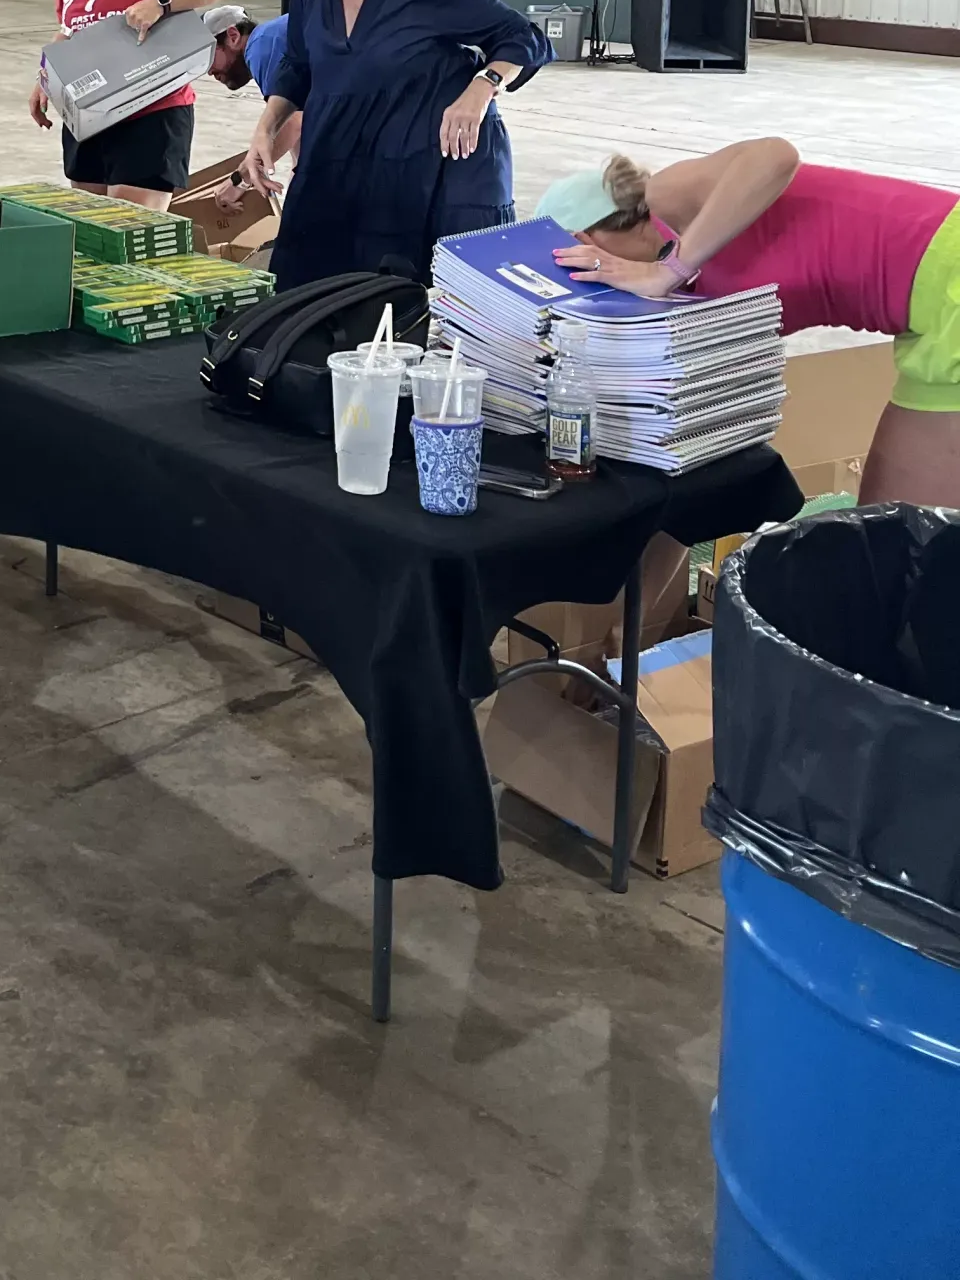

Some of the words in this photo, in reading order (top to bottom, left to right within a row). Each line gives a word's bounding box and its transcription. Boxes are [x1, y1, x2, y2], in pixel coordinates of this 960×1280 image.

[71, 13, 96, 26] FAST
[552, 418, 578, 434] GOLD
[552, 430, 577, 446] PEAK
